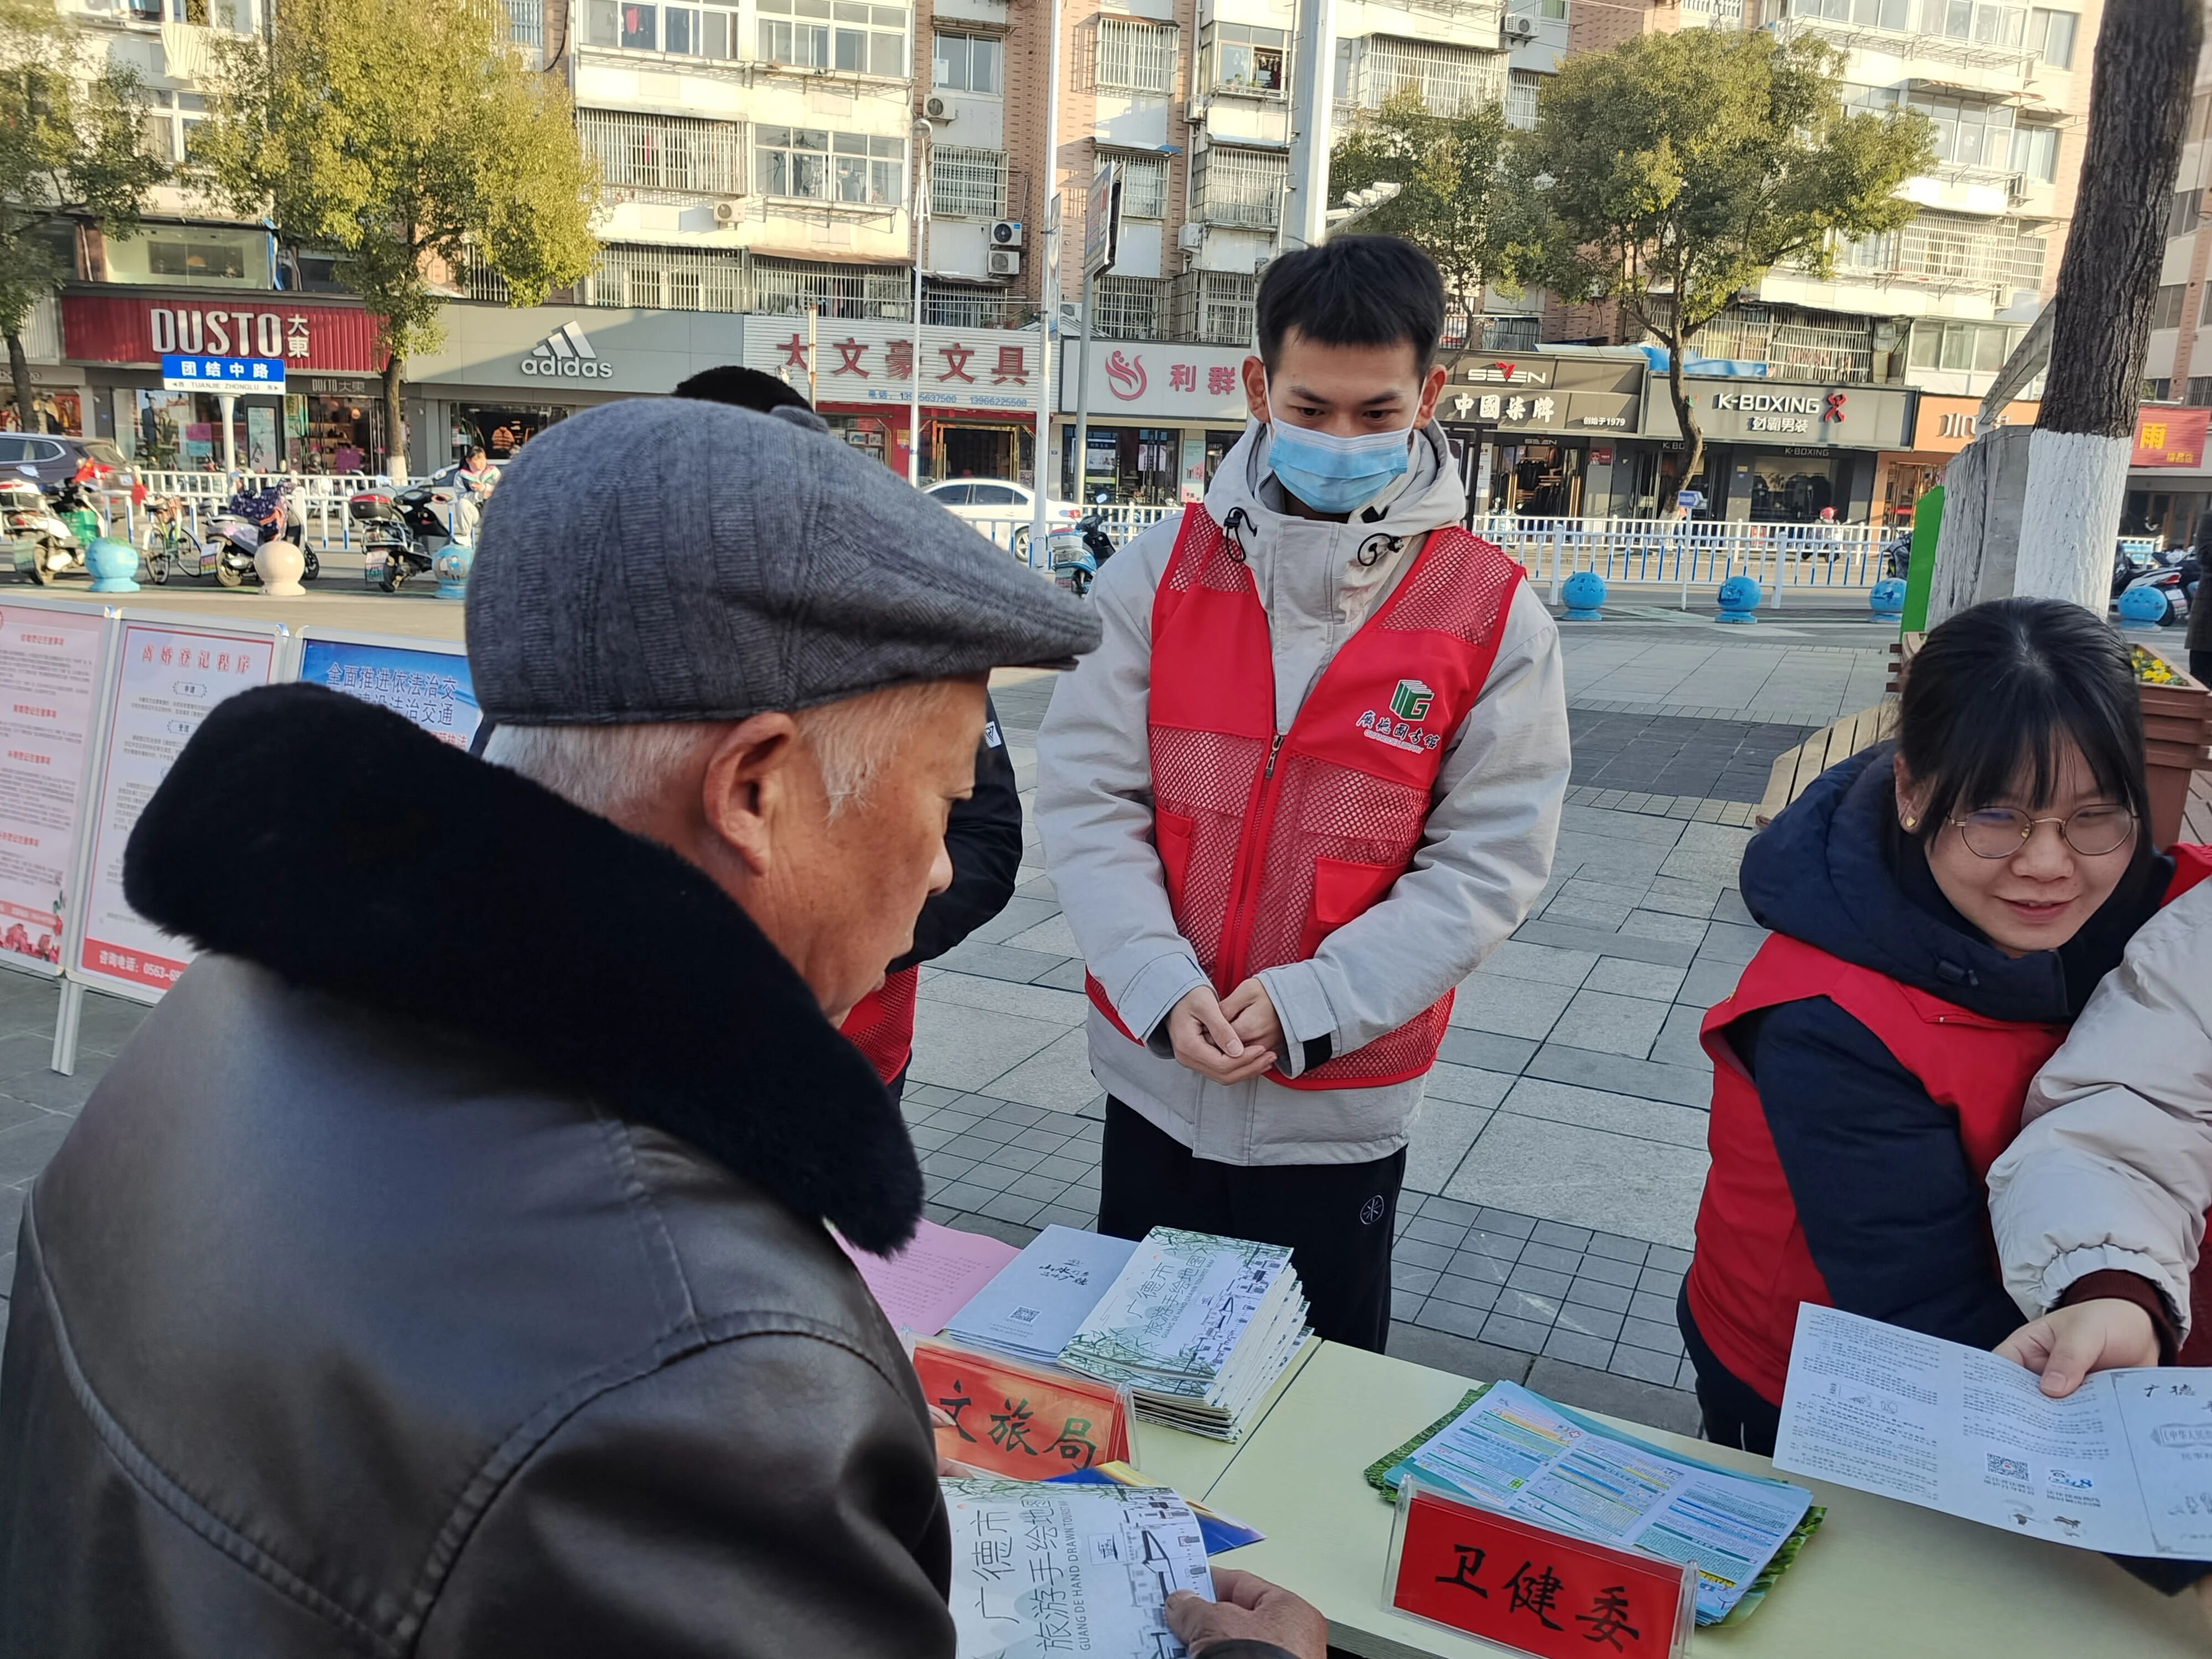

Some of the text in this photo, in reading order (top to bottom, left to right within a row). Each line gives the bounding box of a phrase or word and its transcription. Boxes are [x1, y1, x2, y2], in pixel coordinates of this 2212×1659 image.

[150, 309, 310, 359] DUSTO 大東
[181, 361, 269, 379] 团结中路
[521, 356, 614, 378] adidas
[776, 333, 1030, 387] 大文豪文具
[1169, 364, 1236, 395] 利群
[900, 392, 957, 404] 1395637500
[1454, 393, 1555, 423] 中國柒牌
[1718, 393, 1820, 414] K-BOXING
[1752, 416, 1809, 434] 劲霸男装
[1785, 447, 1829, 457] K-BOXING
[1126, 1261, 1175, 1319] 广德市
[1142, 1255, 1206, 1337] 旅游手绘地图
[1161, 1321, 1176, 1339] GUANG
[939, 1379, 1097, 1472] 文旅局
[1063, 1528, 1079, 1562] DRAWN
[971, 1508, 1020, 1625] 广德市
[1021, 1499, 1074, 1652] 旅游手绘地图
[1068, 1565, 1083, 1598] HAND
[1073, 1599, 1086, 1613] DE
[1434, 1543, 1640, 1653] 卫健委
[1075, 1615, 1091, 1651] GUANG
